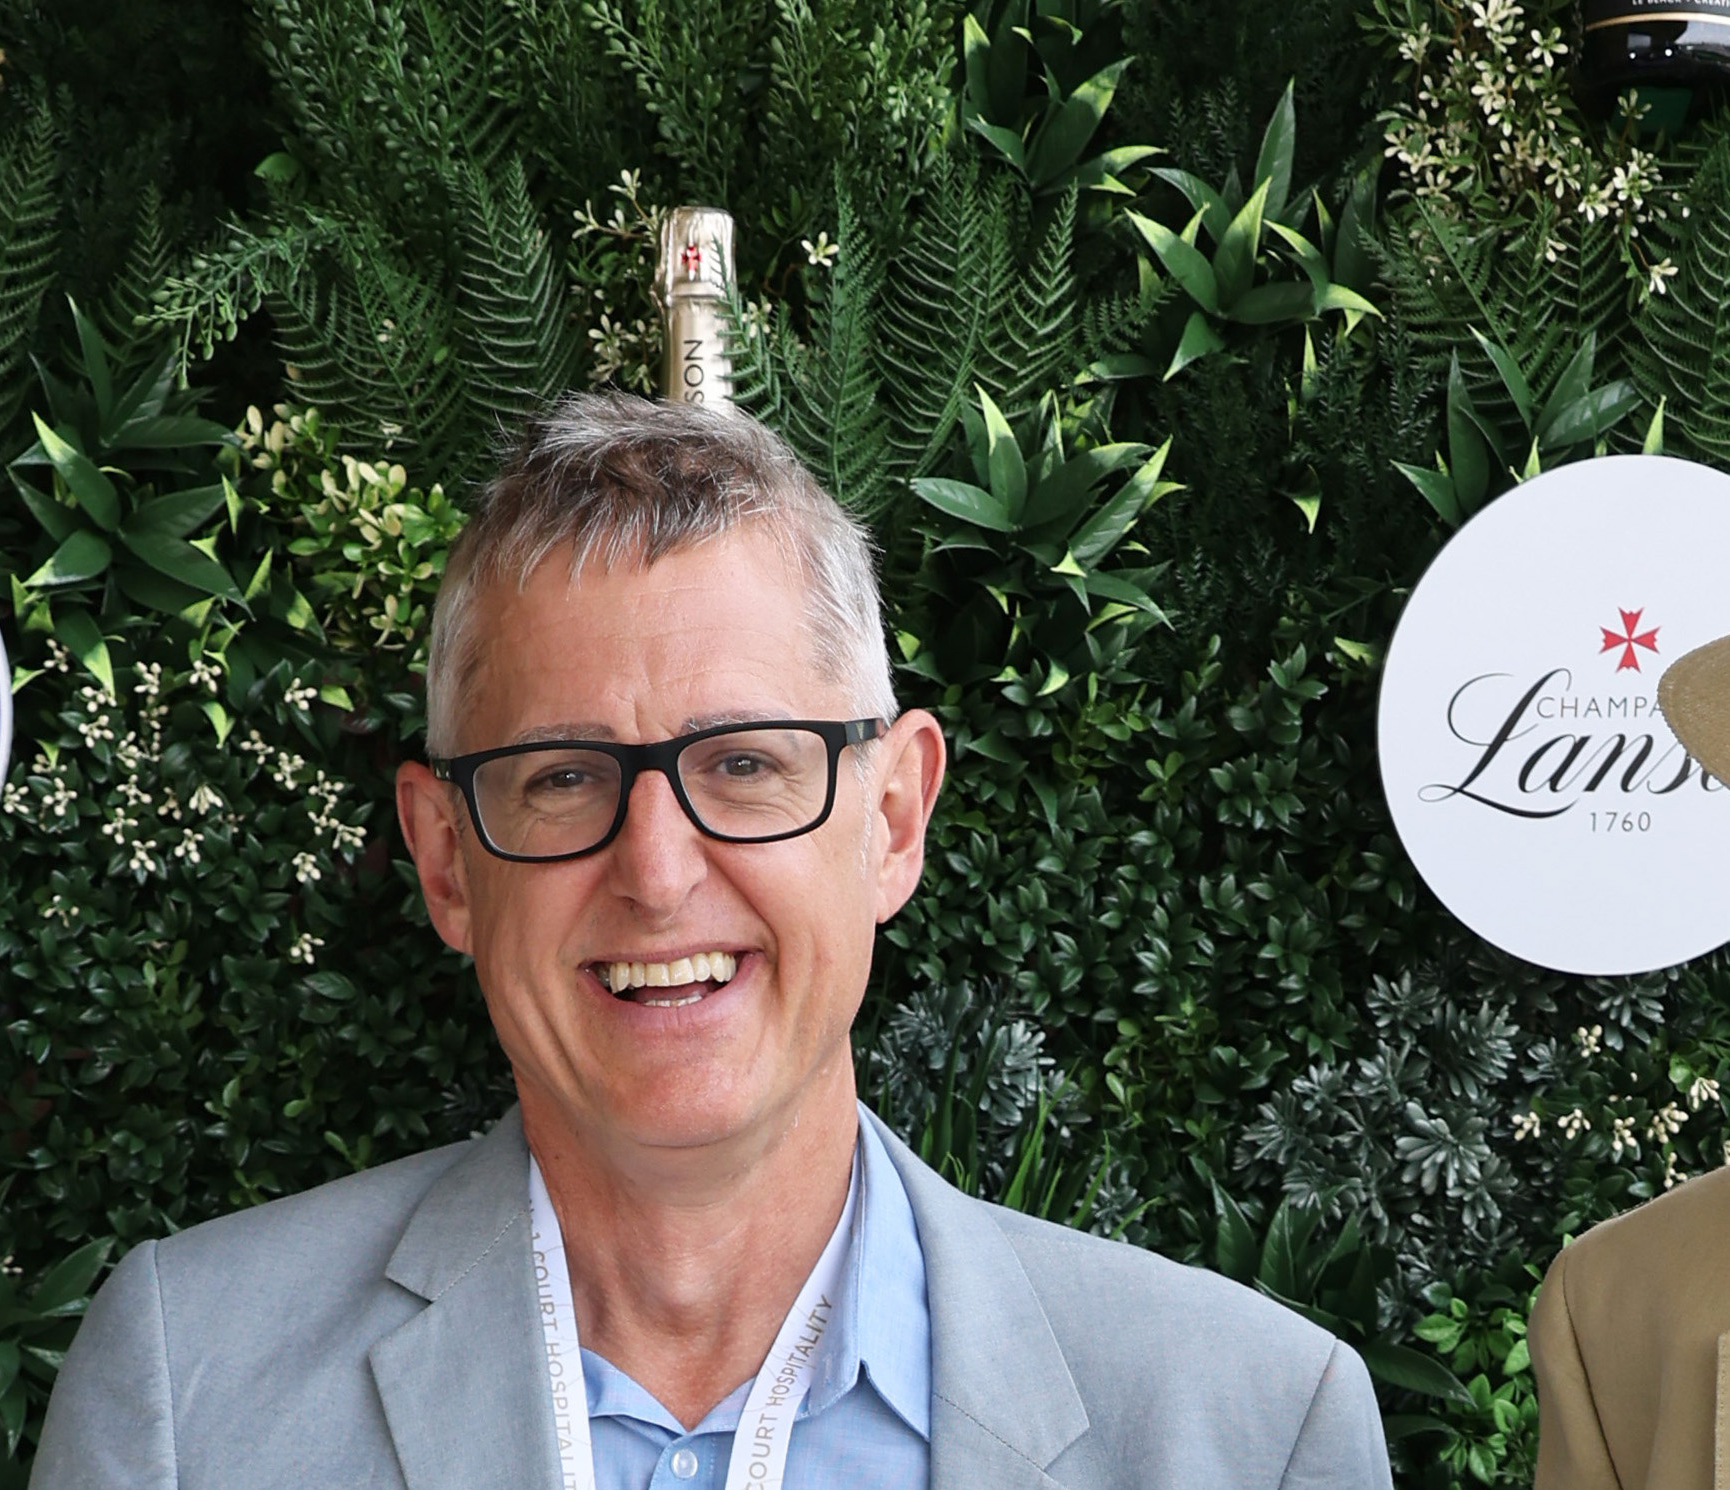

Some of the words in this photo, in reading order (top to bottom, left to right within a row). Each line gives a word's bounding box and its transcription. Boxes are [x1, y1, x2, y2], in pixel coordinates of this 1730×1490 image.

[684, 339, 704, 404] SON
[1537, 696, 1662, 719] CHAMPA
[1590, 811, 1652, 833] 1760
[765, 1294, 833, 1407] HOSPITALITY
